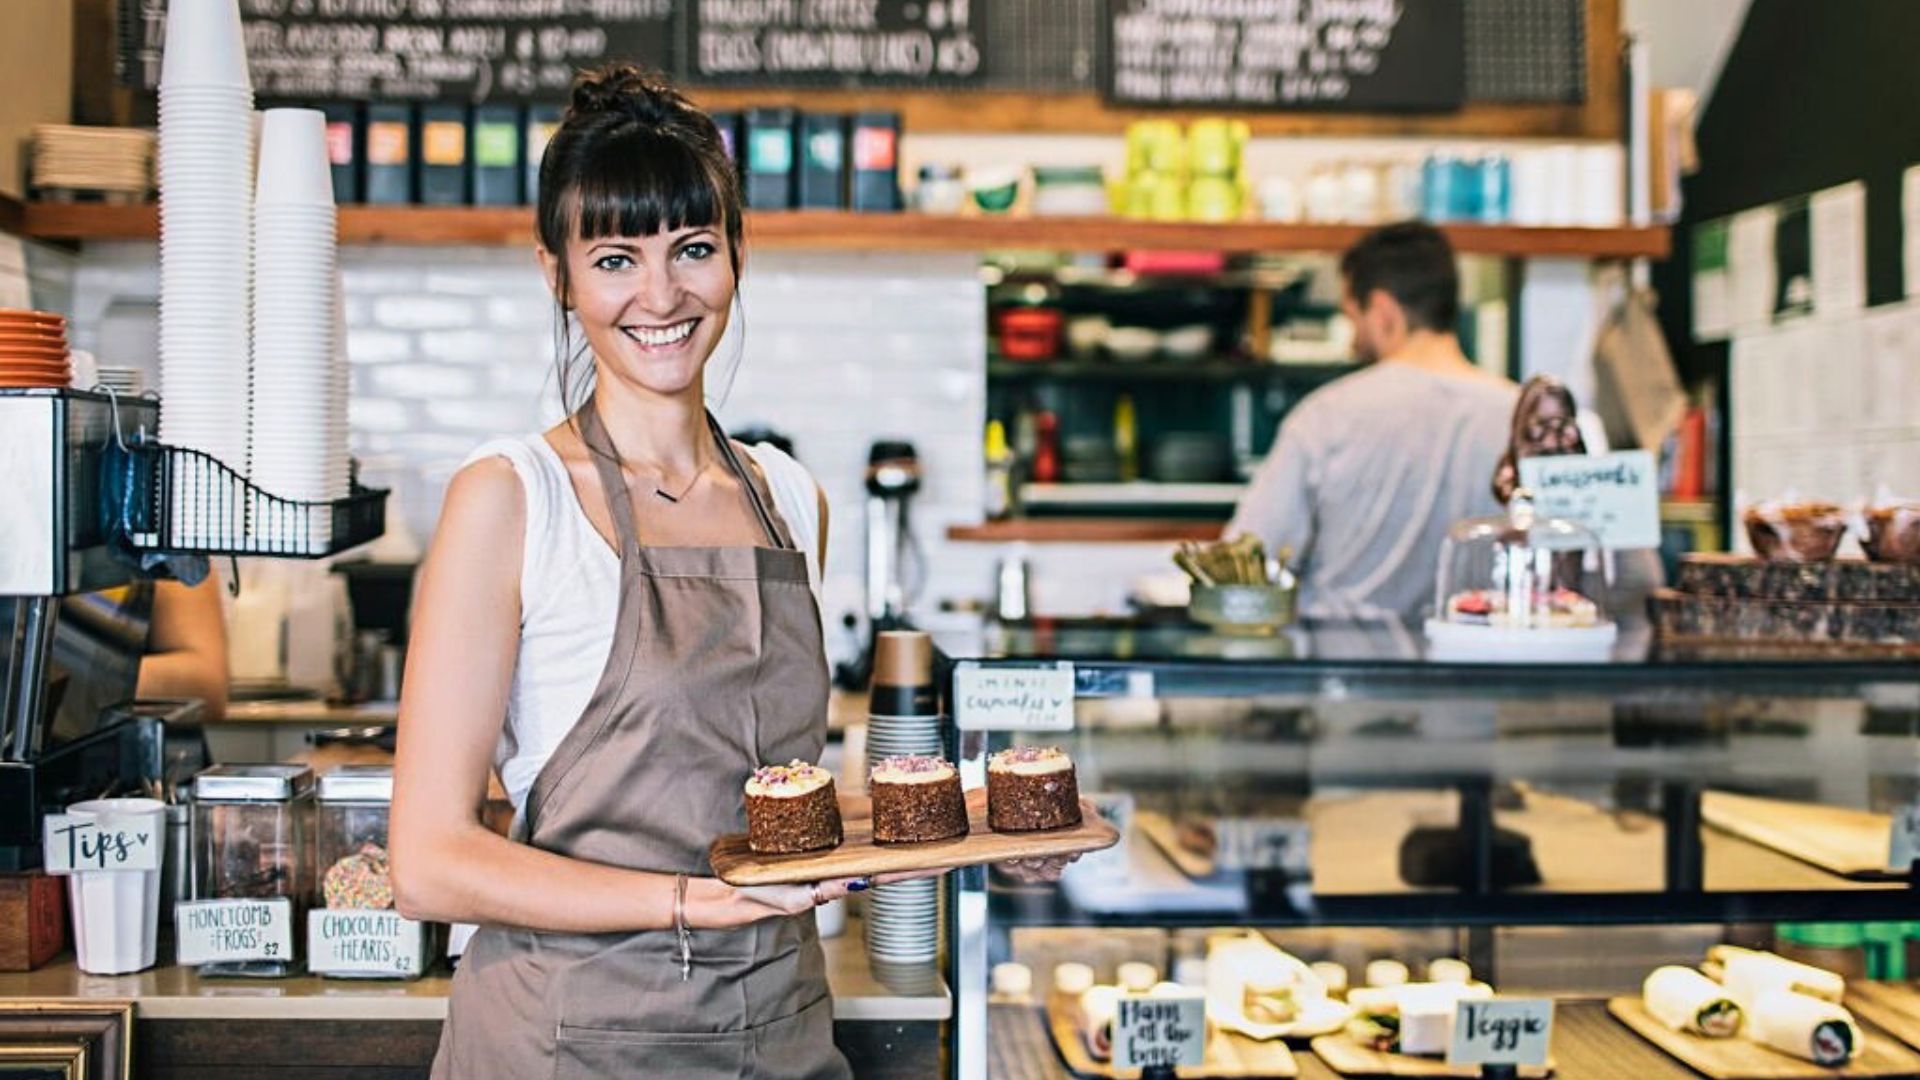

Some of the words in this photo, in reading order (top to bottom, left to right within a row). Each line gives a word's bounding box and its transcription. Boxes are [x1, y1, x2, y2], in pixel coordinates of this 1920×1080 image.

[54, 822, 136, 869] Tips
[188, 904, 272, 931] HONEYCOMB
[322, 915, 401, 939] CHOCOLATE
[263, 941, 280, 956] $2
[1120, 999, 1181, 1029] Ham
[1464, 1004, 1546, 1051] Veggie
